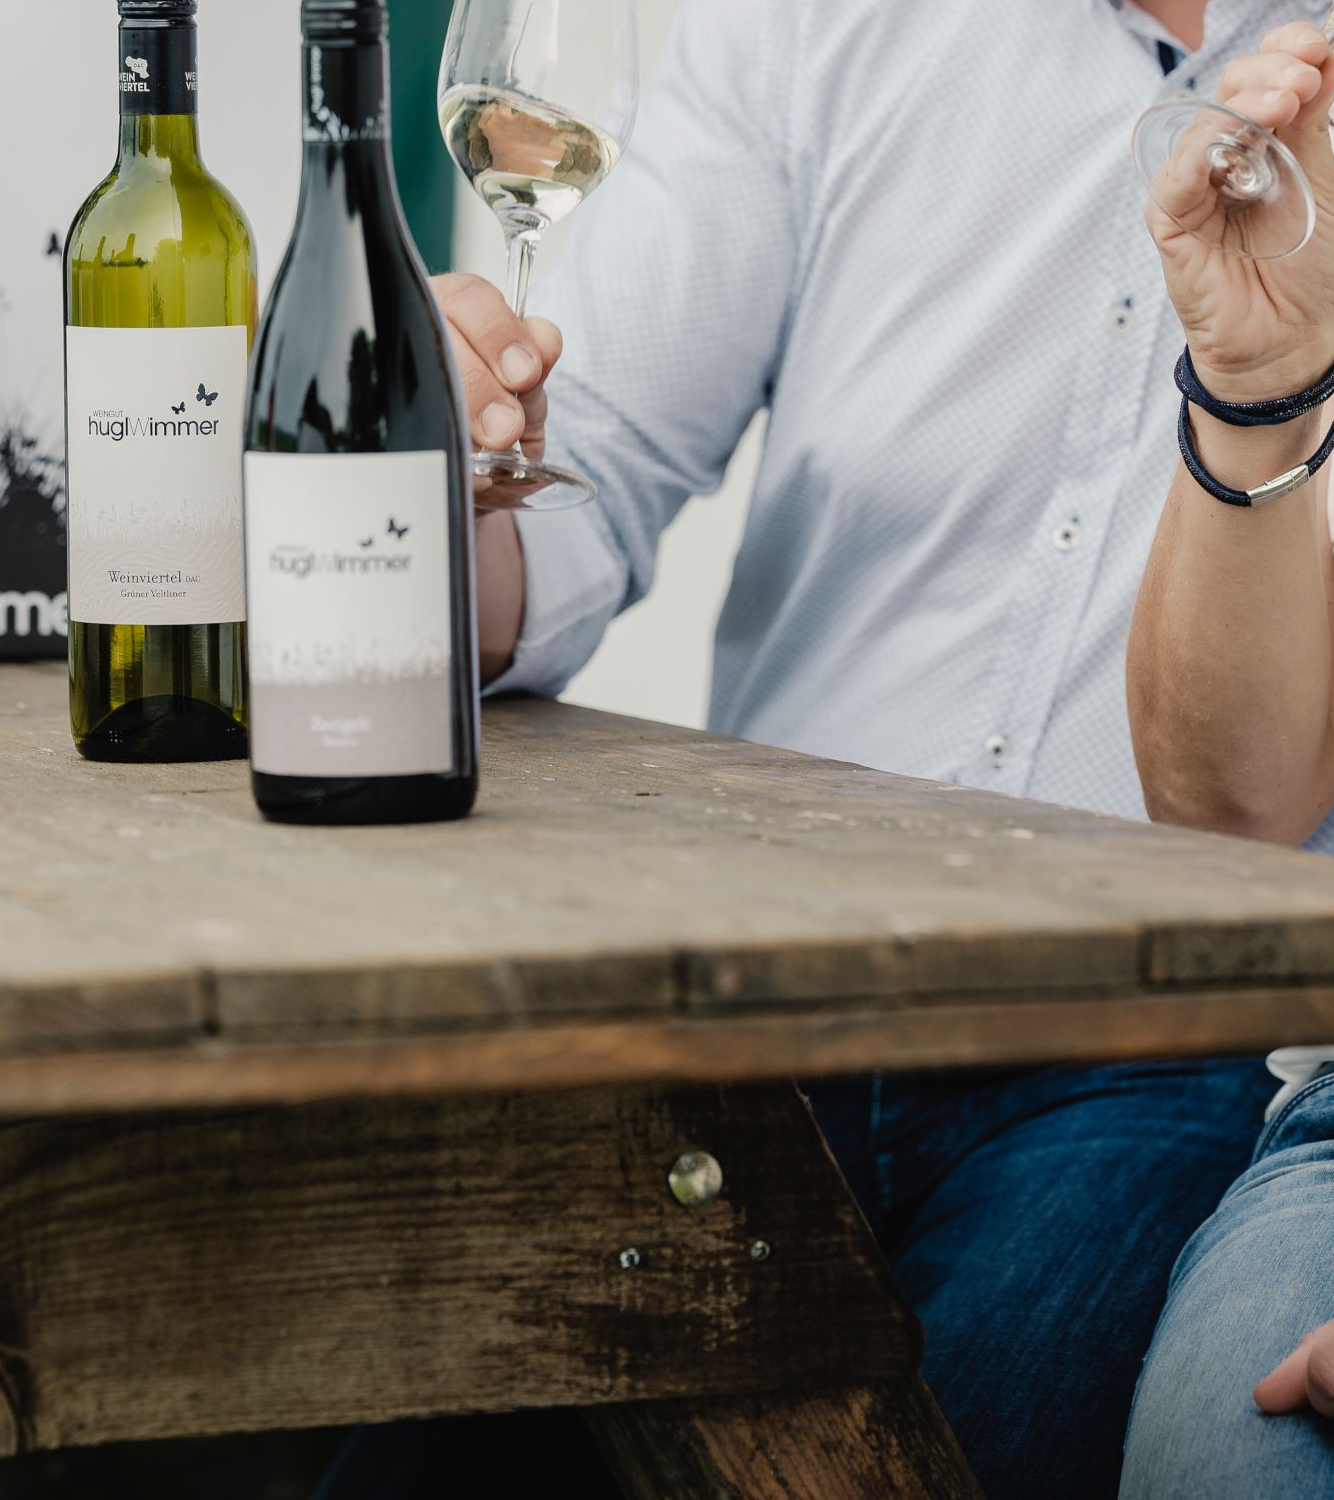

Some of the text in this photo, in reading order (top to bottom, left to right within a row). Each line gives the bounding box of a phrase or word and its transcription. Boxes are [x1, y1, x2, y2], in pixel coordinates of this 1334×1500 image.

[92, 410, 124, 418] WEINGUT
[88, 416, 219, 442] huglWimmer
[108, 570, 201, 584] Weinviertel DAC
[120, 589, 187, 598] Grüner Veltliner
